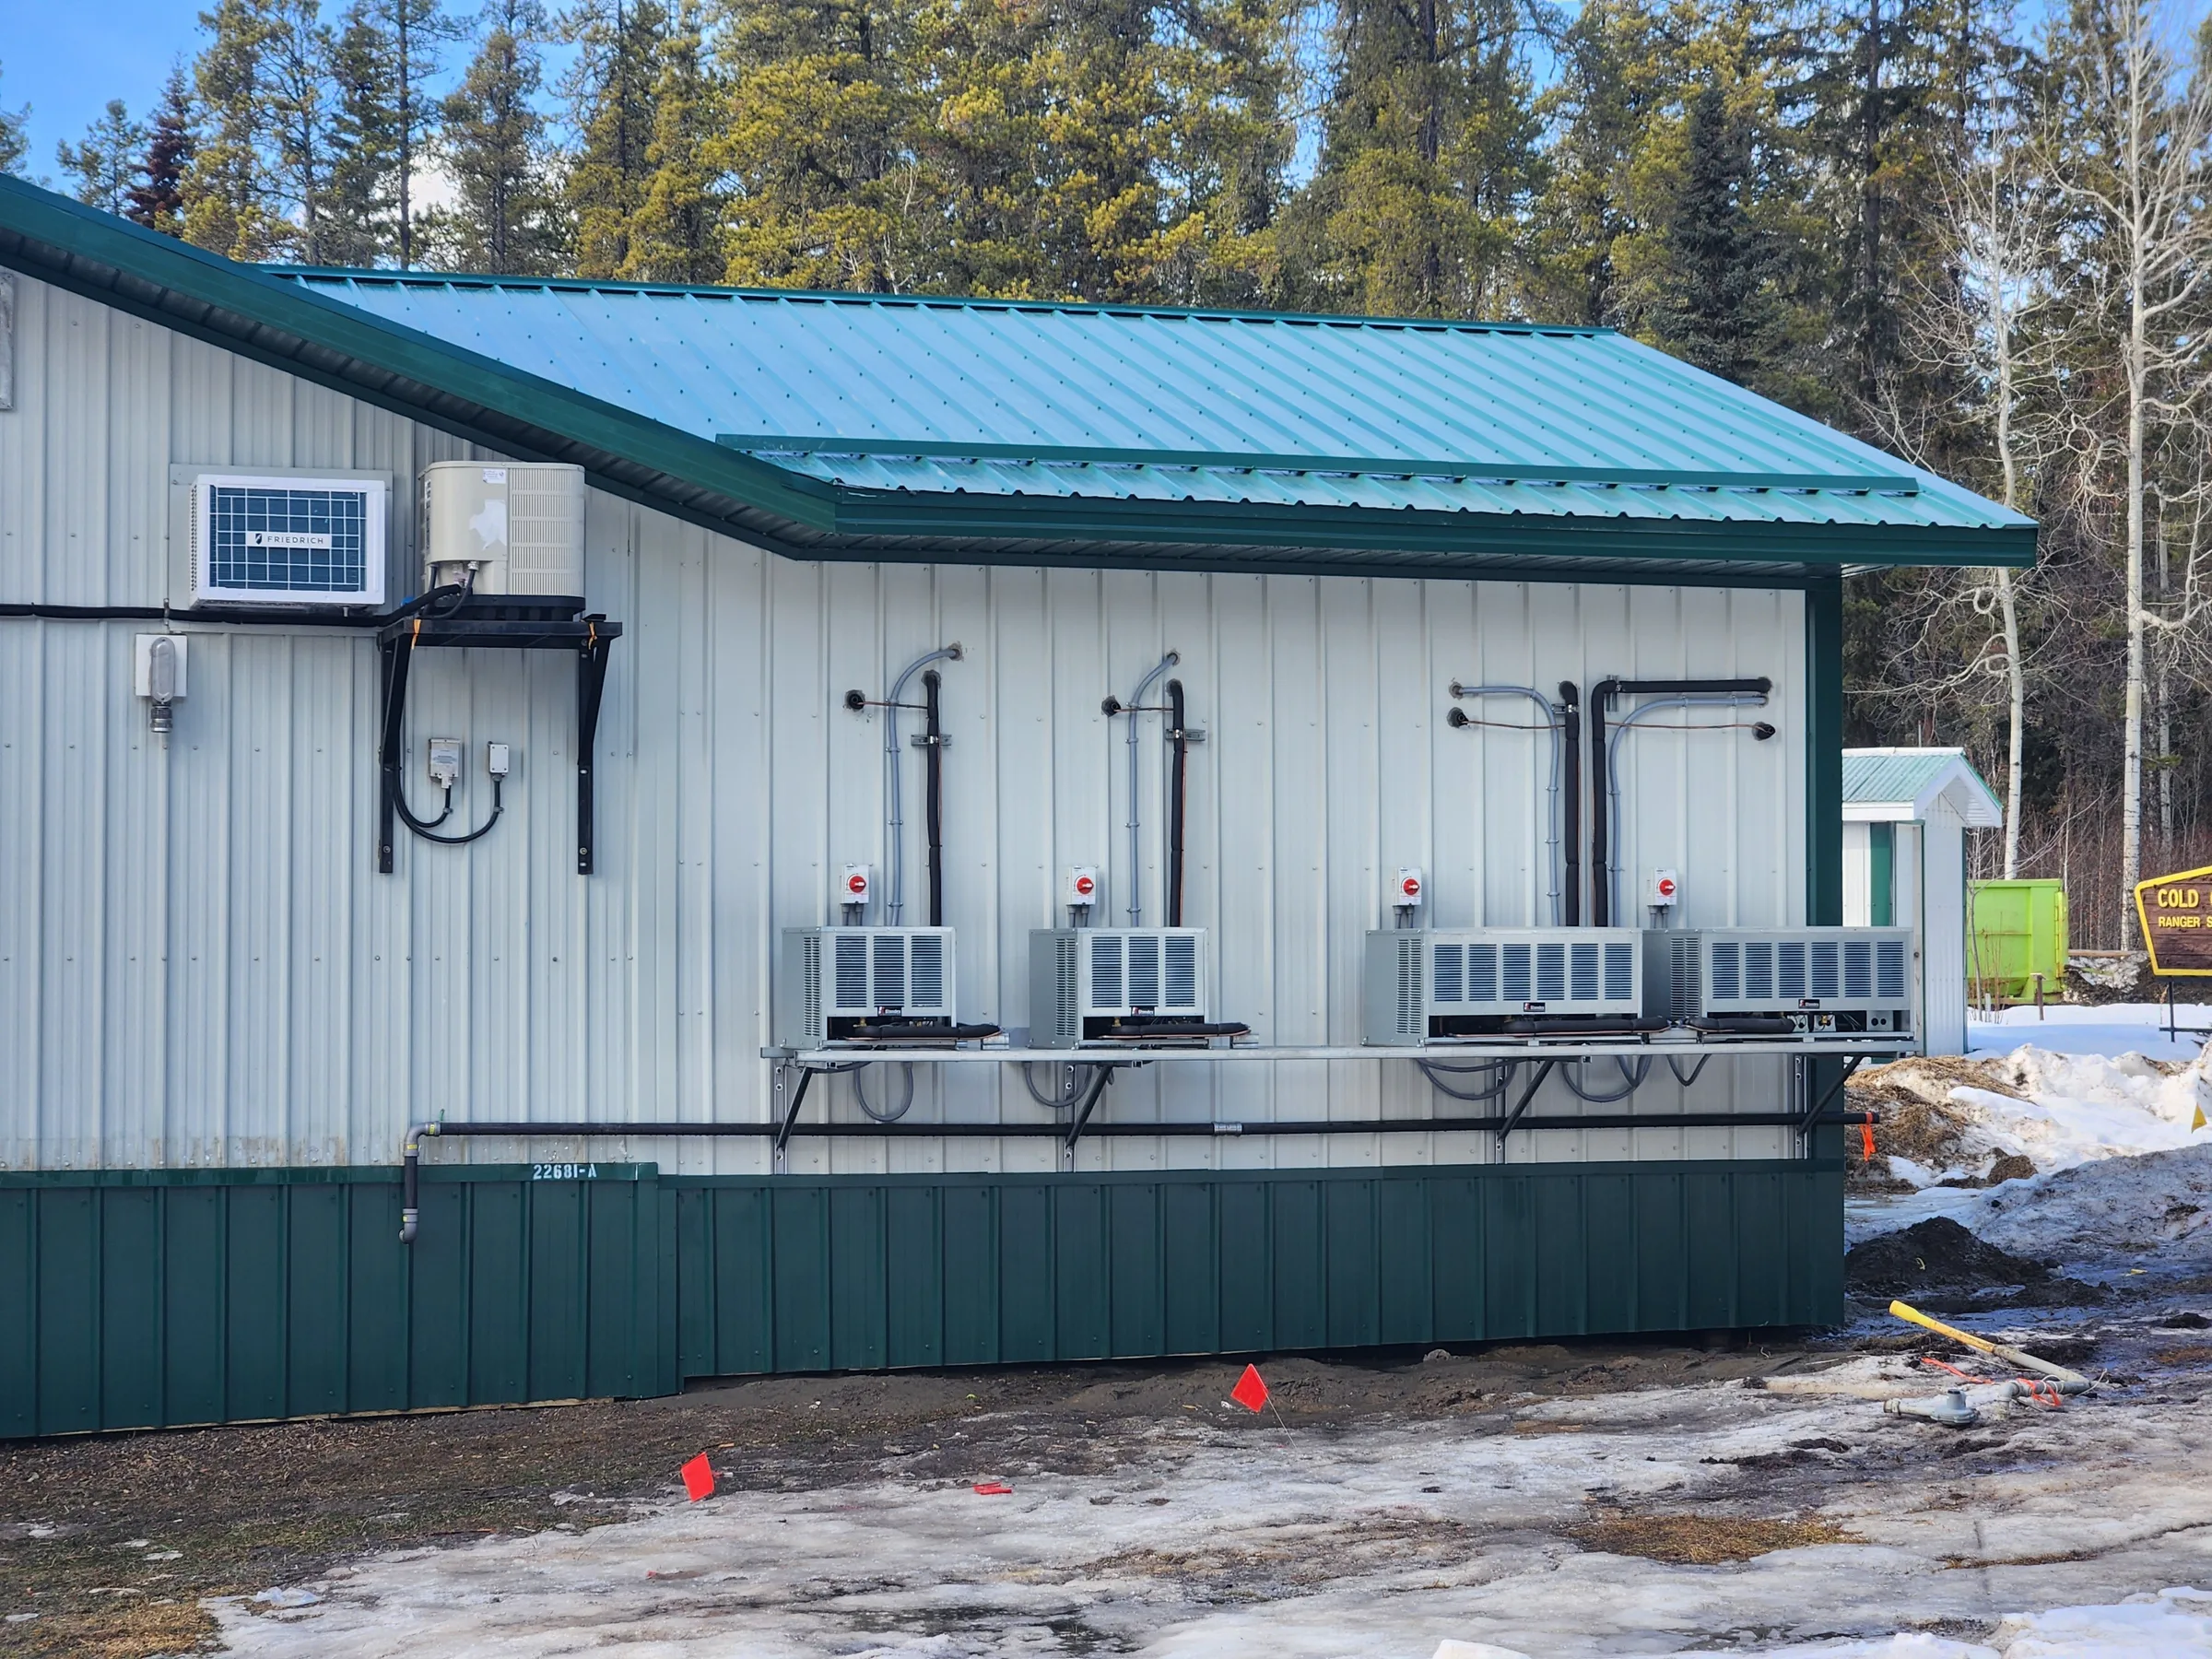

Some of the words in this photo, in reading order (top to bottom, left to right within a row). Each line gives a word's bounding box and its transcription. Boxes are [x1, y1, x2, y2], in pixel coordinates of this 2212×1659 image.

[267, 535, 324, 544] FRIEDRICH
[2158, 888, 2199, 908] COLD
[2158, 916, 2201, 928] RANGER
[533, 1163, 597, 1179] 22681-A
